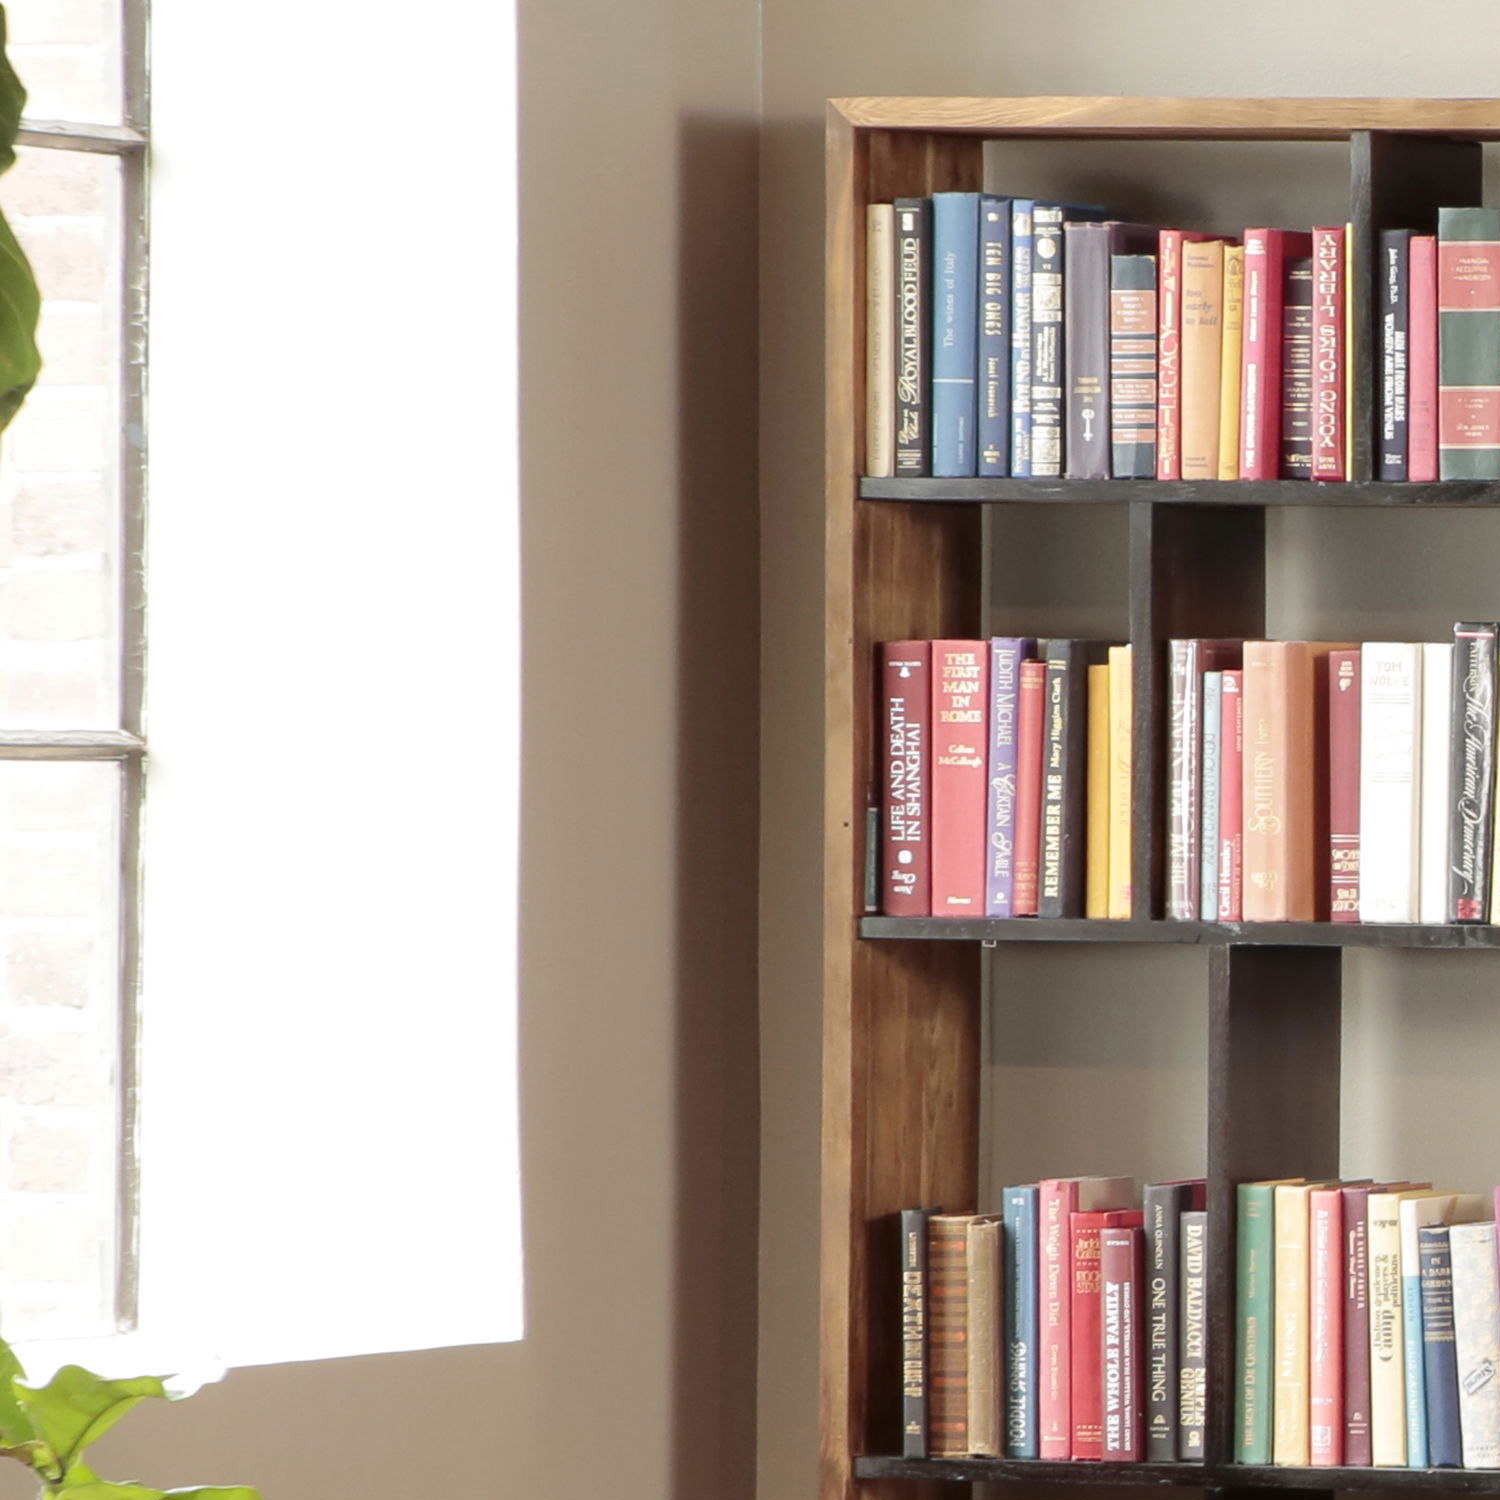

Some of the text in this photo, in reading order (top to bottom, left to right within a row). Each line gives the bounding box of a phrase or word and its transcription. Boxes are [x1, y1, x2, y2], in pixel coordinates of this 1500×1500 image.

[943, 251, 957, 348] The wines of Italy
[985, 242, 1002, 335] TEN BIG ONES
[1185, 302, 1213, 314] early
[1387, 248, 1398, 304] John Gray, Ph.D.
[897, 238, 919, 405] ROYAL BLOOD FEUD
[1012, 293, 1031, 413] BOUND HONOR
[1318, 234, 1337, 448] YOUNG FOLKS LIBRARY
[987, 357, 999, 418] Janet Evanovich
[1159, 325, 1178, 410] LEGACY
[1384, 313, 1394, 439] WOMEN ARE FROM VENUS
[1395, 331, 1405, 421] MEN ARE FROM MARS
[1245, 449, 1255, 468] THE
[942, 666, 981, 678] FIRST
[942, 681, 980, 693] MAN
[945, 653, 975, 665] THE
[994, 649, 1016, 747] JUDITH MICHAEL
[1376, 661, 1402, 673] TOM
[940, 710, 982, 723] ROME
[952, 695, 970, 708] IN
[1049, 677, 1062, 768] Mary Higgins Clark
[890, 698, 905, 841] LIFE AND DEATH
[906, 723, 921, 842] IN SHANGHAI
[1117, 756, 1130, 827] Divorce
[1248, 751, 1281, 836] SOUTHERN
[1452, 688, 1489, 885] The American Democracy
[991, 762, 1016, 878] A CERTAIN SMILE
[1044, 775, 1062, 897] REMEMBER ME
[1219, 888, 1231, 917] Cecil
[1046, 1198, 1061, 1327] The Weigh Down Diet
[1154, 1204, 1164, 1269] ANNA QUINDLEN
[903, 1271, 923, 1339] DEATH
[1186, 1225, 1202, 1358] DAVID BALDACCI
[1381, 1269, 1391, 1302] players
[1389, 1254, 1400, 1307] politicians
[1106, 1281, 1120, 1451] THE WHOLE FAMILY
[1152, 1277, 1166, 1402] ONE TRUE THING
[1281, 1313, 1297, 1378] MAKING
[1377, 1309, 1395, 1362] Camp
[1009, 1341, 1027, 1447] POODLE SPRINGS
[1180, 1367, 1194, 1426] GENIUS
[1194, 1367, 1206, 1426] SIMPLE
[1243, 1386, 1254, 1447] THE BEST OF
